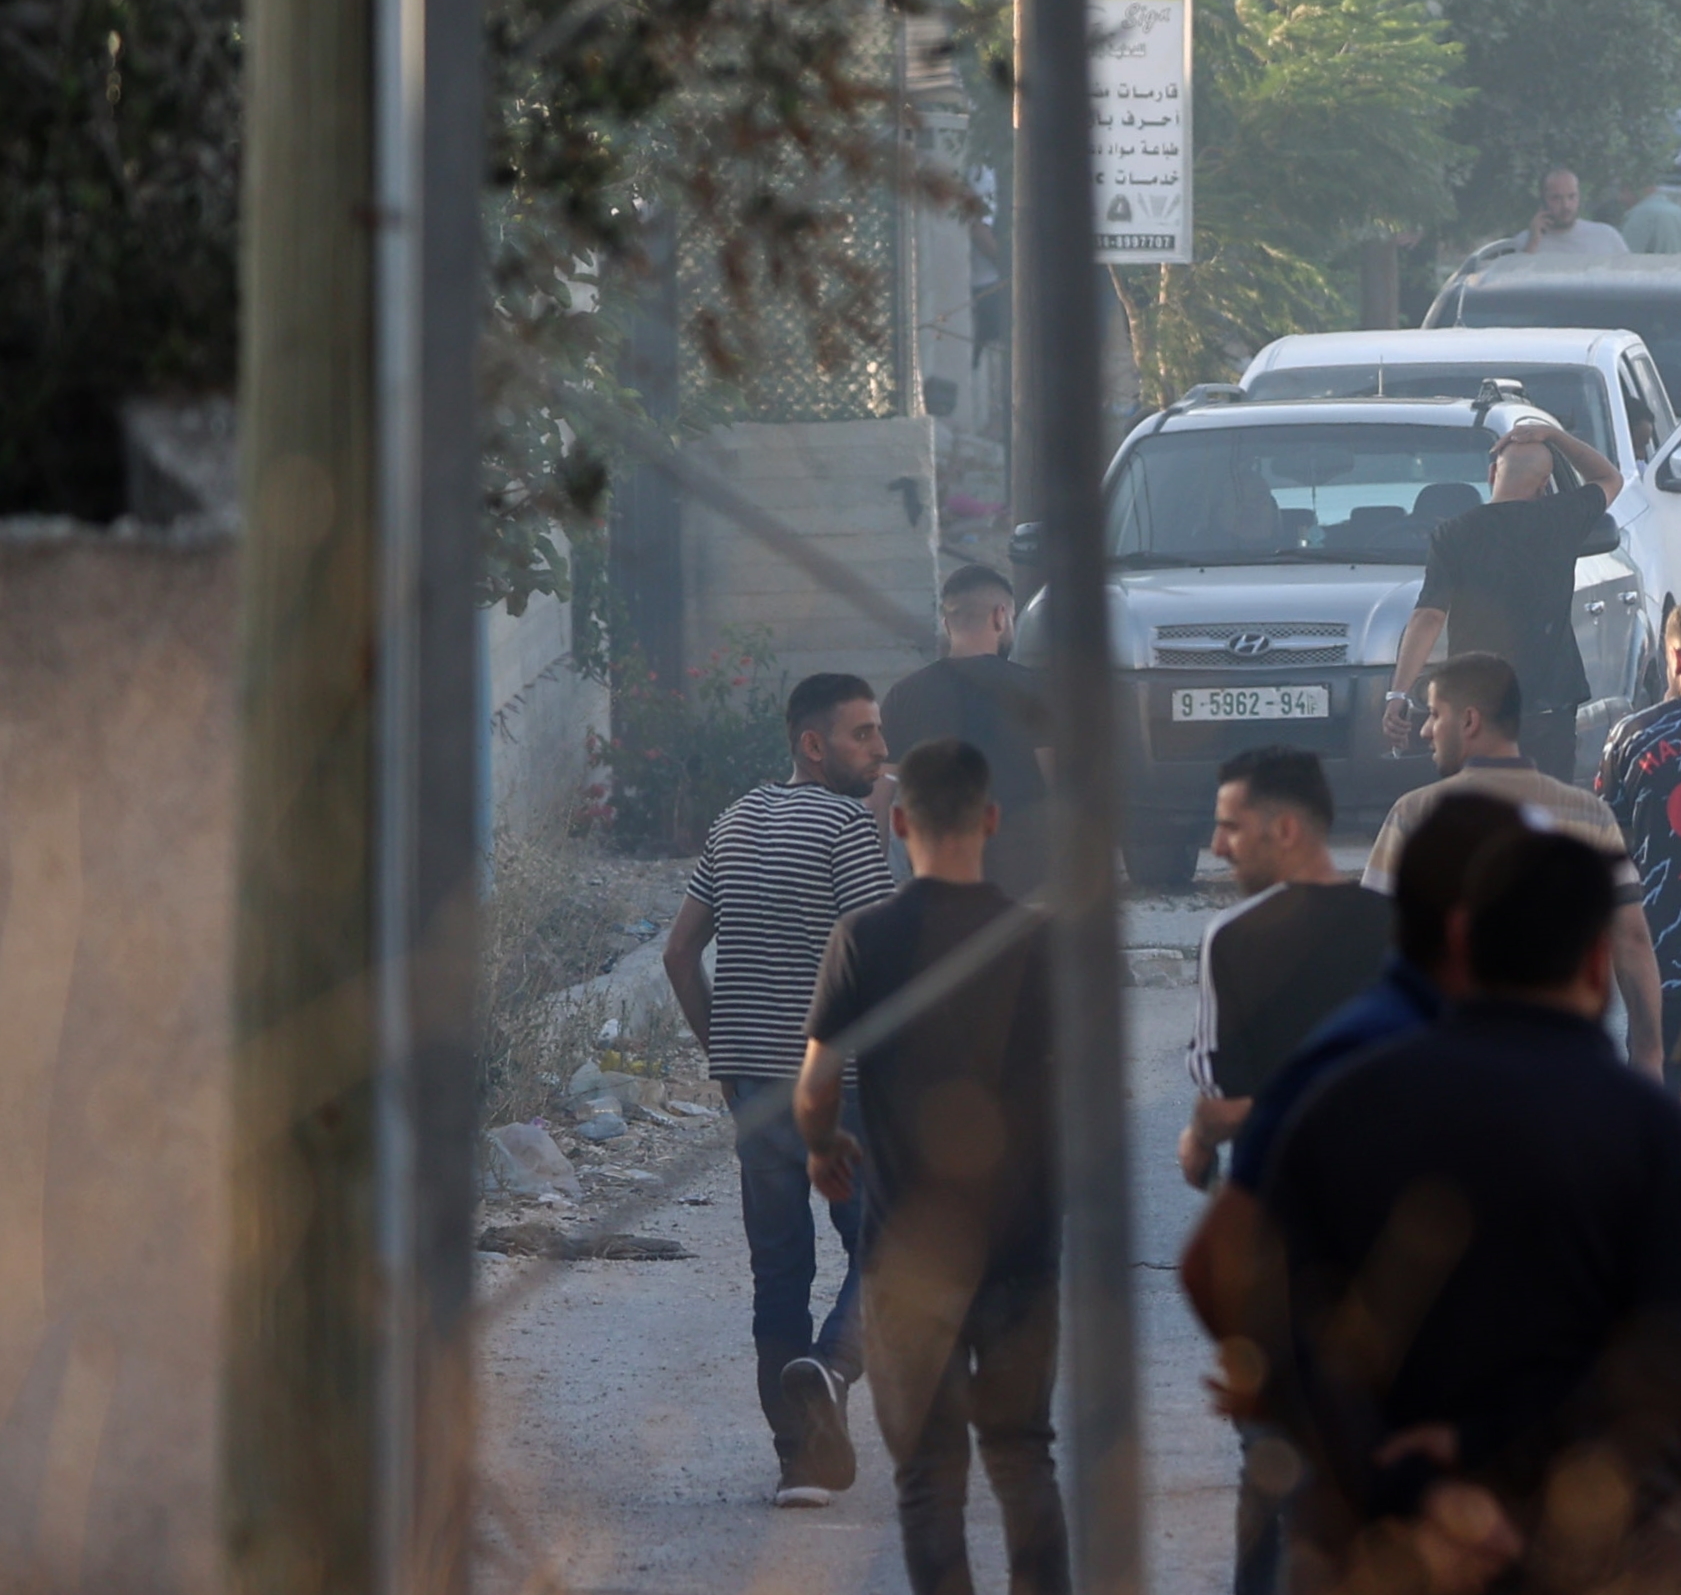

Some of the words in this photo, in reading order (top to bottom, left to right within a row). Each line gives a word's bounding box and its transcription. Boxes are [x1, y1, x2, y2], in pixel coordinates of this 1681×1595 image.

[1118, 82, 1178, 102] قارمات
[1141, 141, 1179, 160] طباعة
[1115, 170, 1179, 186] خدمات
